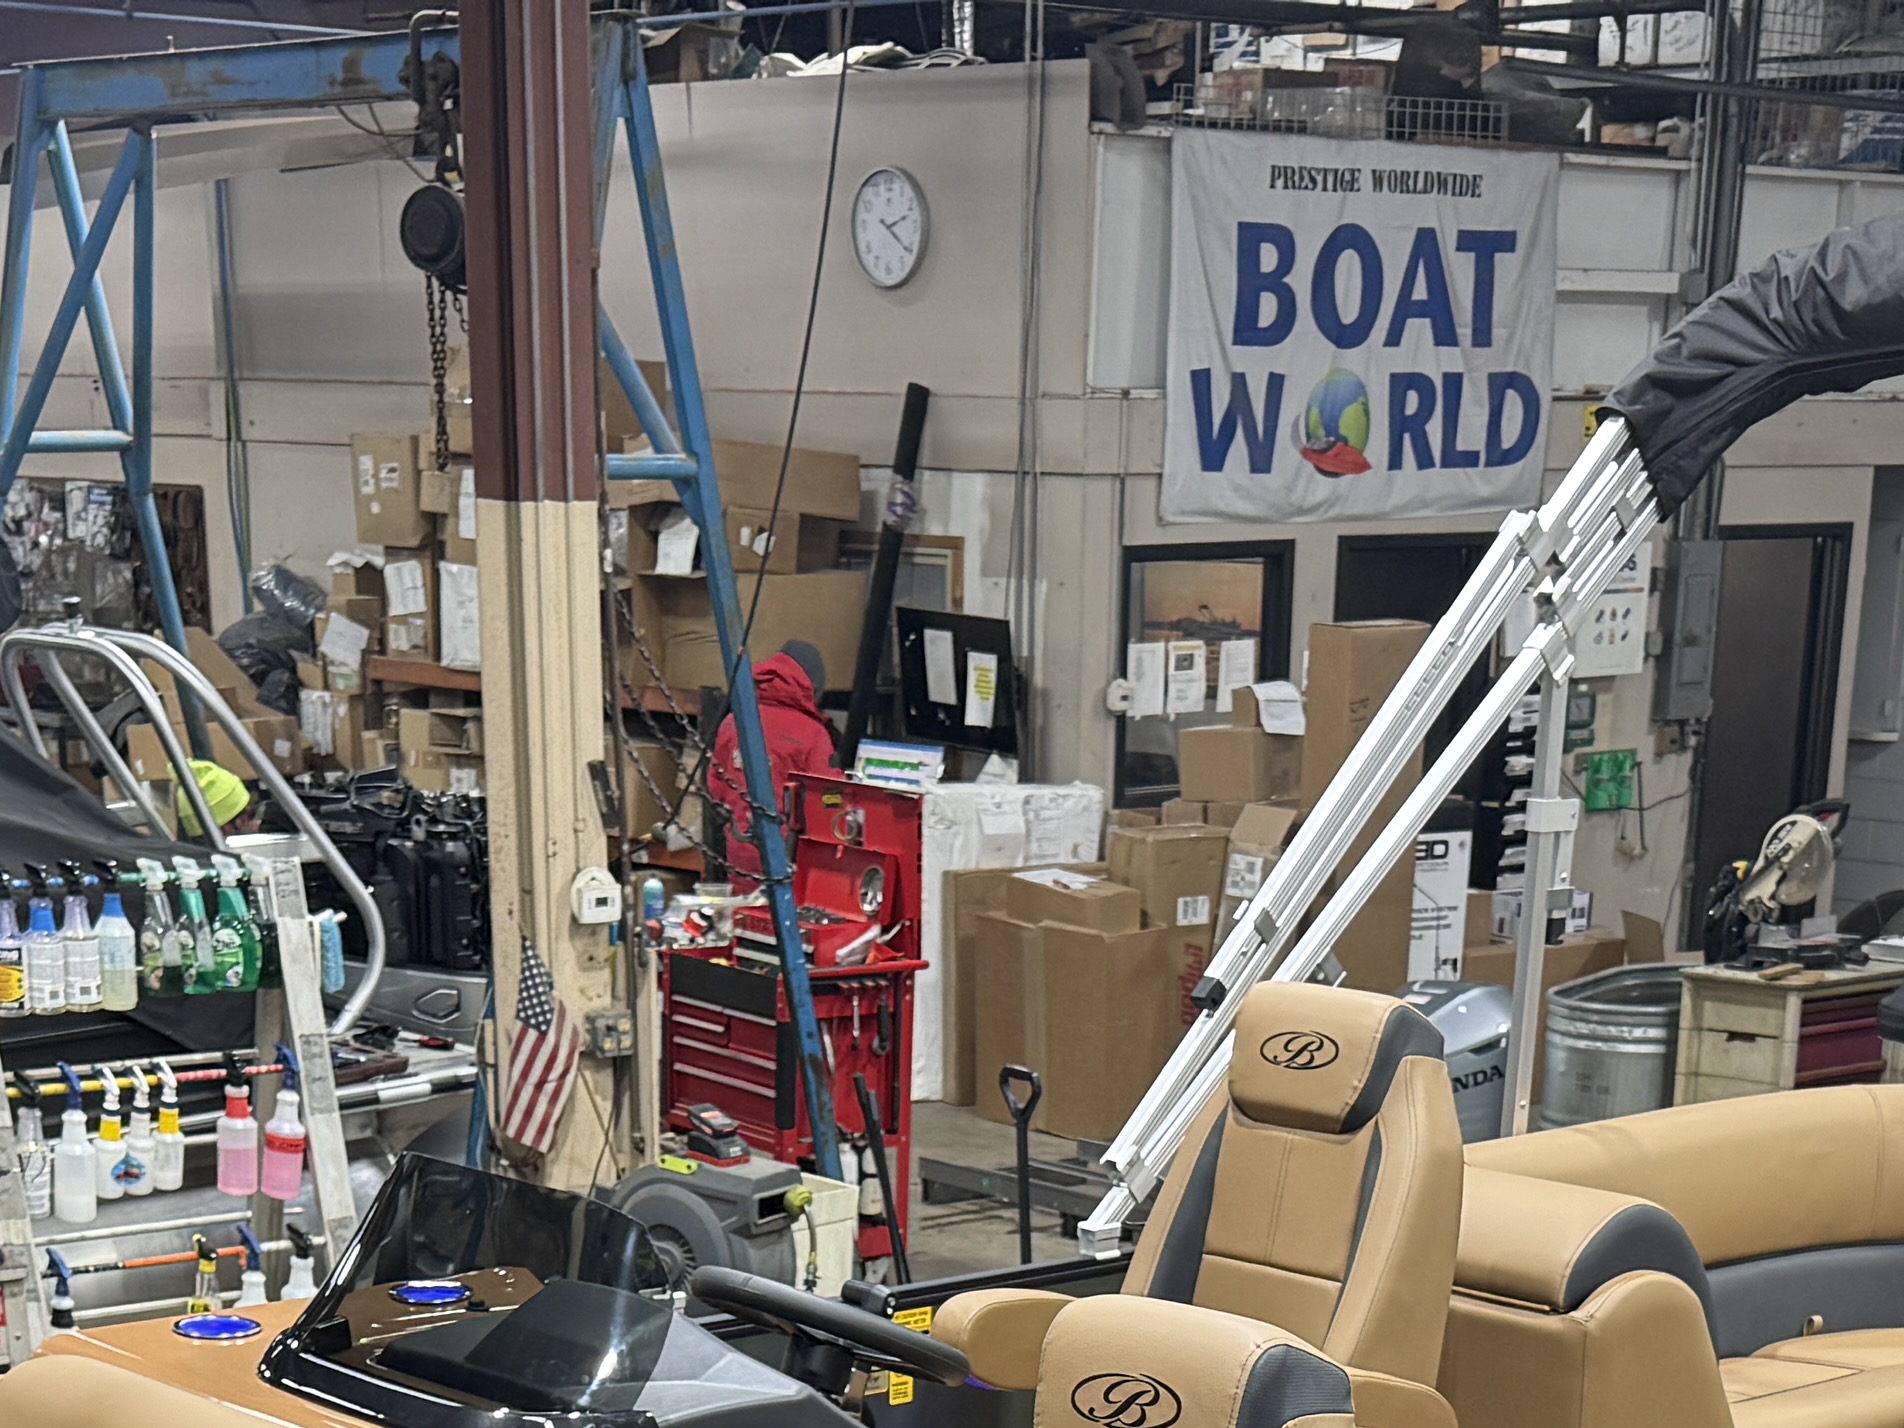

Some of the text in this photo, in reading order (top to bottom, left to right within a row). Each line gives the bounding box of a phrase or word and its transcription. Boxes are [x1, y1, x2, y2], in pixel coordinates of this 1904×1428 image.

[1269, 164, 1484, 199] PRESTIGE WORLDWIDE
[1231, 220, 1517, 350] BOAT
[1453, 1064, 1506, 1093] NDA
